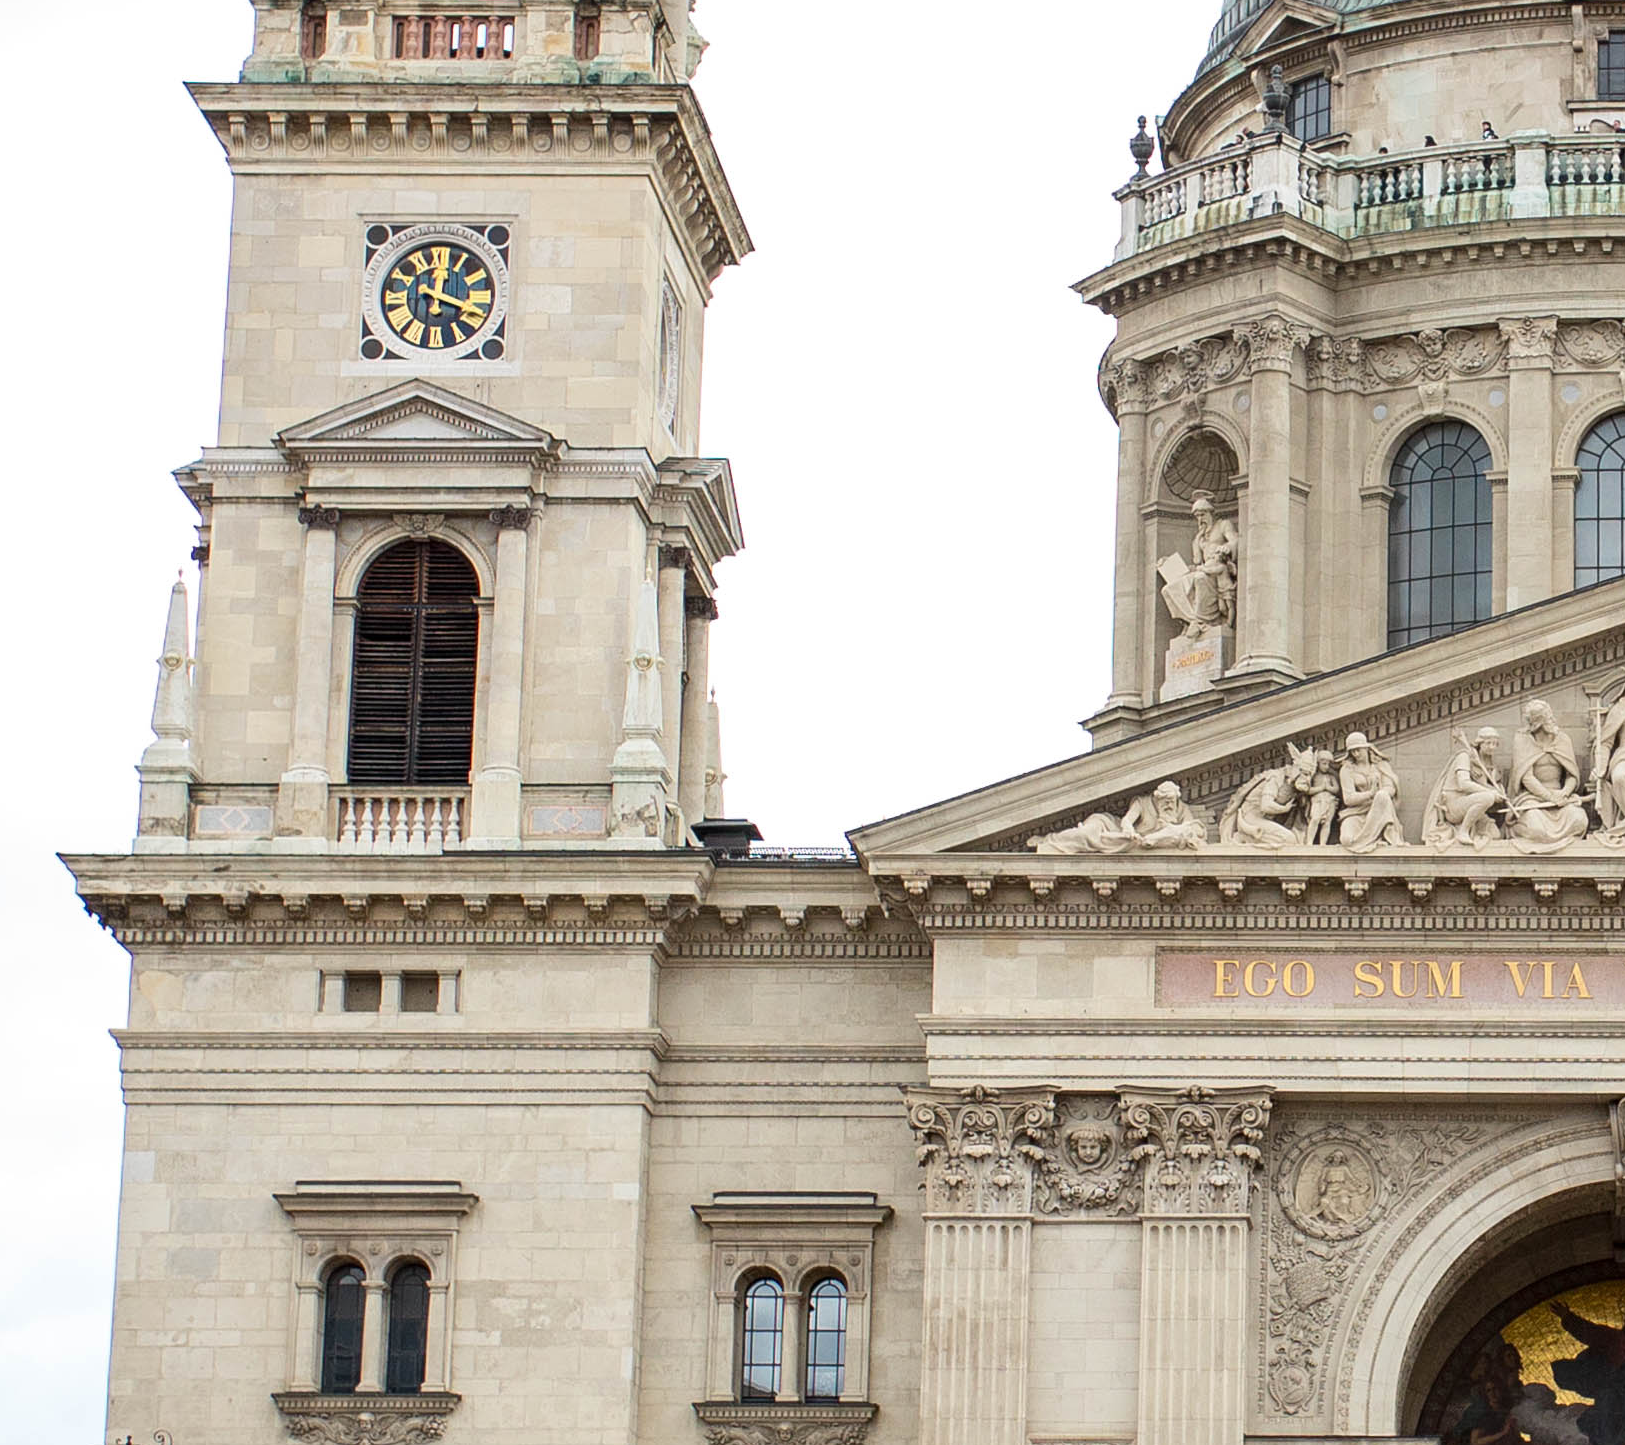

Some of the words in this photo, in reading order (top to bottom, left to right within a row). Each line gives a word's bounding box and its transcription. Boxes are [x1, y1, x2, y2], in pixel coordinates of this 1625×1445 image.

[1213, 960, 1315, 998] EGO
[1353, 960, 1464, 998] SUM
[1503, 961, 1593, 998] VIA
